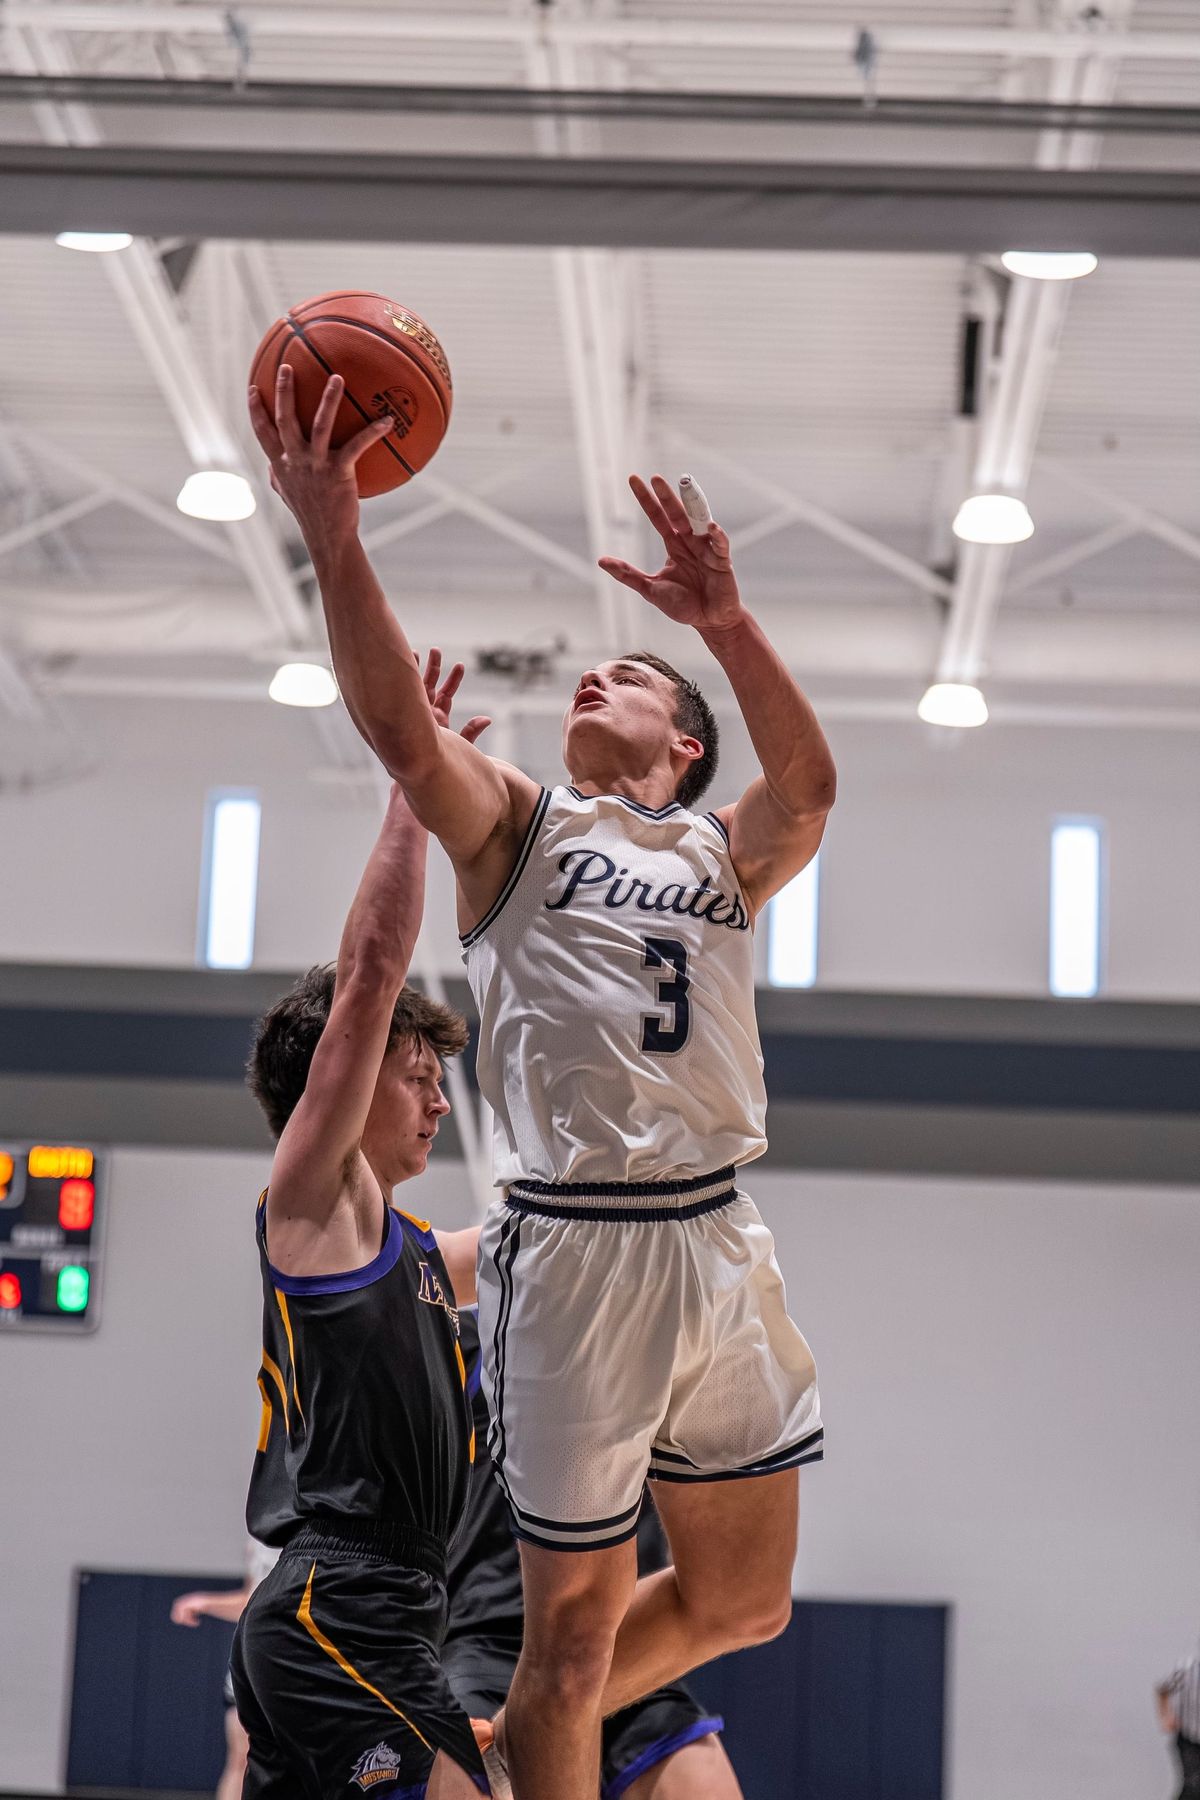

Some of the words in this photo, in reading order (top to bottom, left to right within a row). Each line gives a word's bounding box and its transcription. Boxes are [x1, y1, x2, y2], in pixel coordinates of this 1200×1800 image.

[545, 850, 748, 930] Pirates
[640, 935, 692, 1055] 3
[359, 1769, 396, 1786] MUSTANGS
